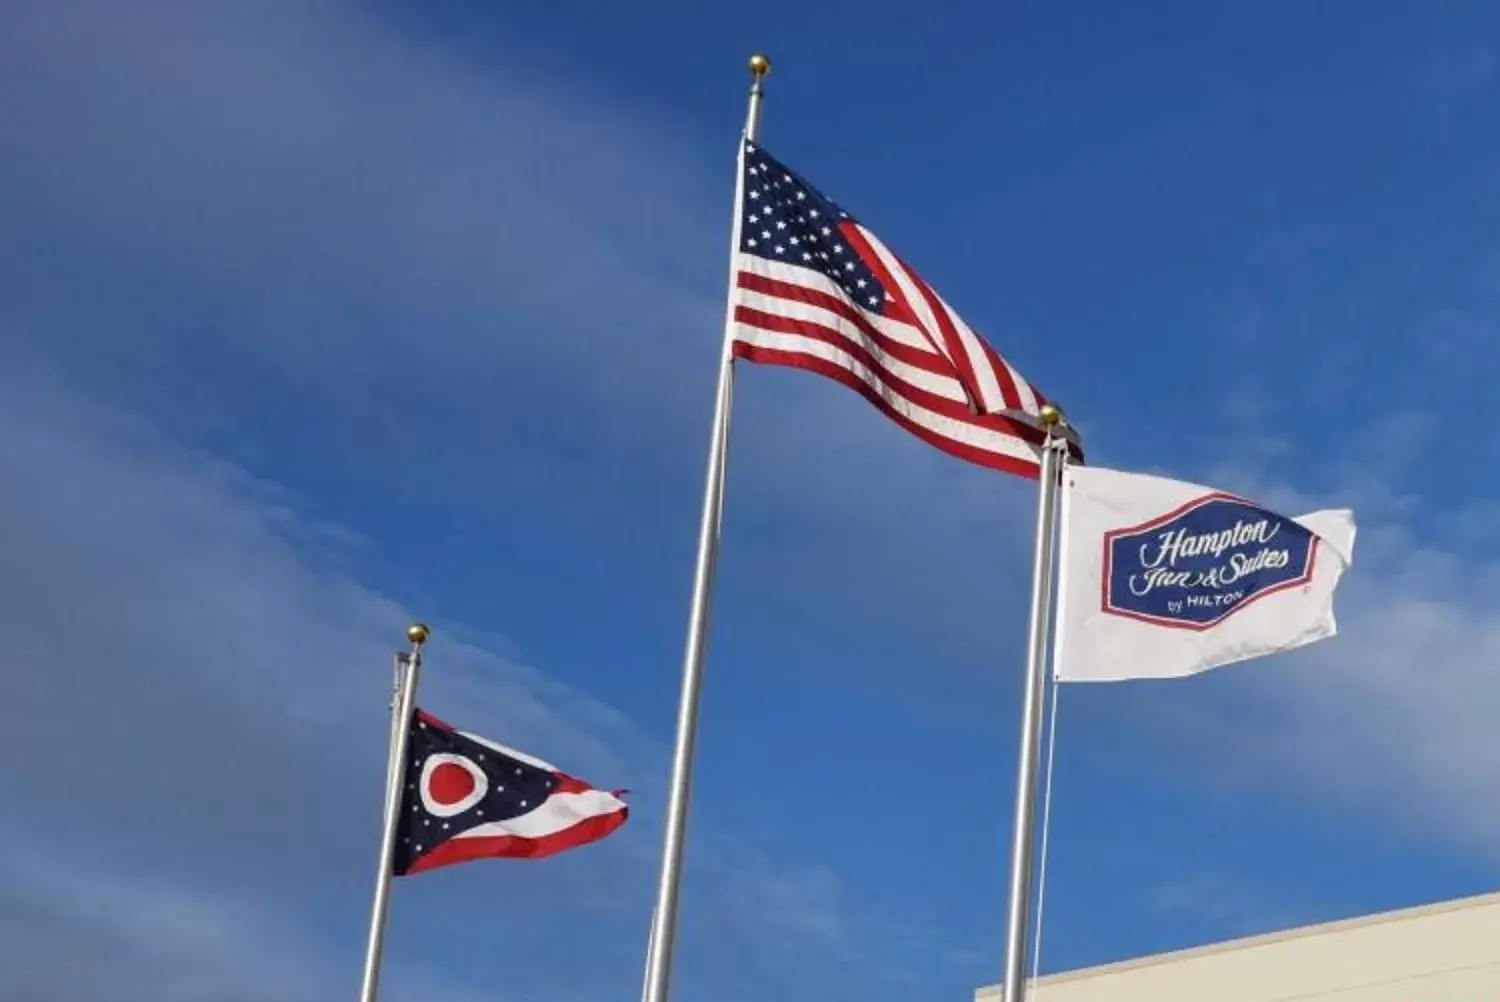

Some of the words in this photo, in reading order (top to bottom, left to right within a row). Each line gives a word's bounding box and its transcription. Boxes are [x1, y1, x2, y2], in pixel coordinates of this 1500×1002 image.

[1139, 520, 1281, 568] Hampton
[1129, 566, 1202, 596] Inn
[1201, 567, 1221, 588] &
[1219, 547, 1289, 584] Suites
[1167, 600, 1183, 613] by
[1187, 589, 1244, 608] HILTON
